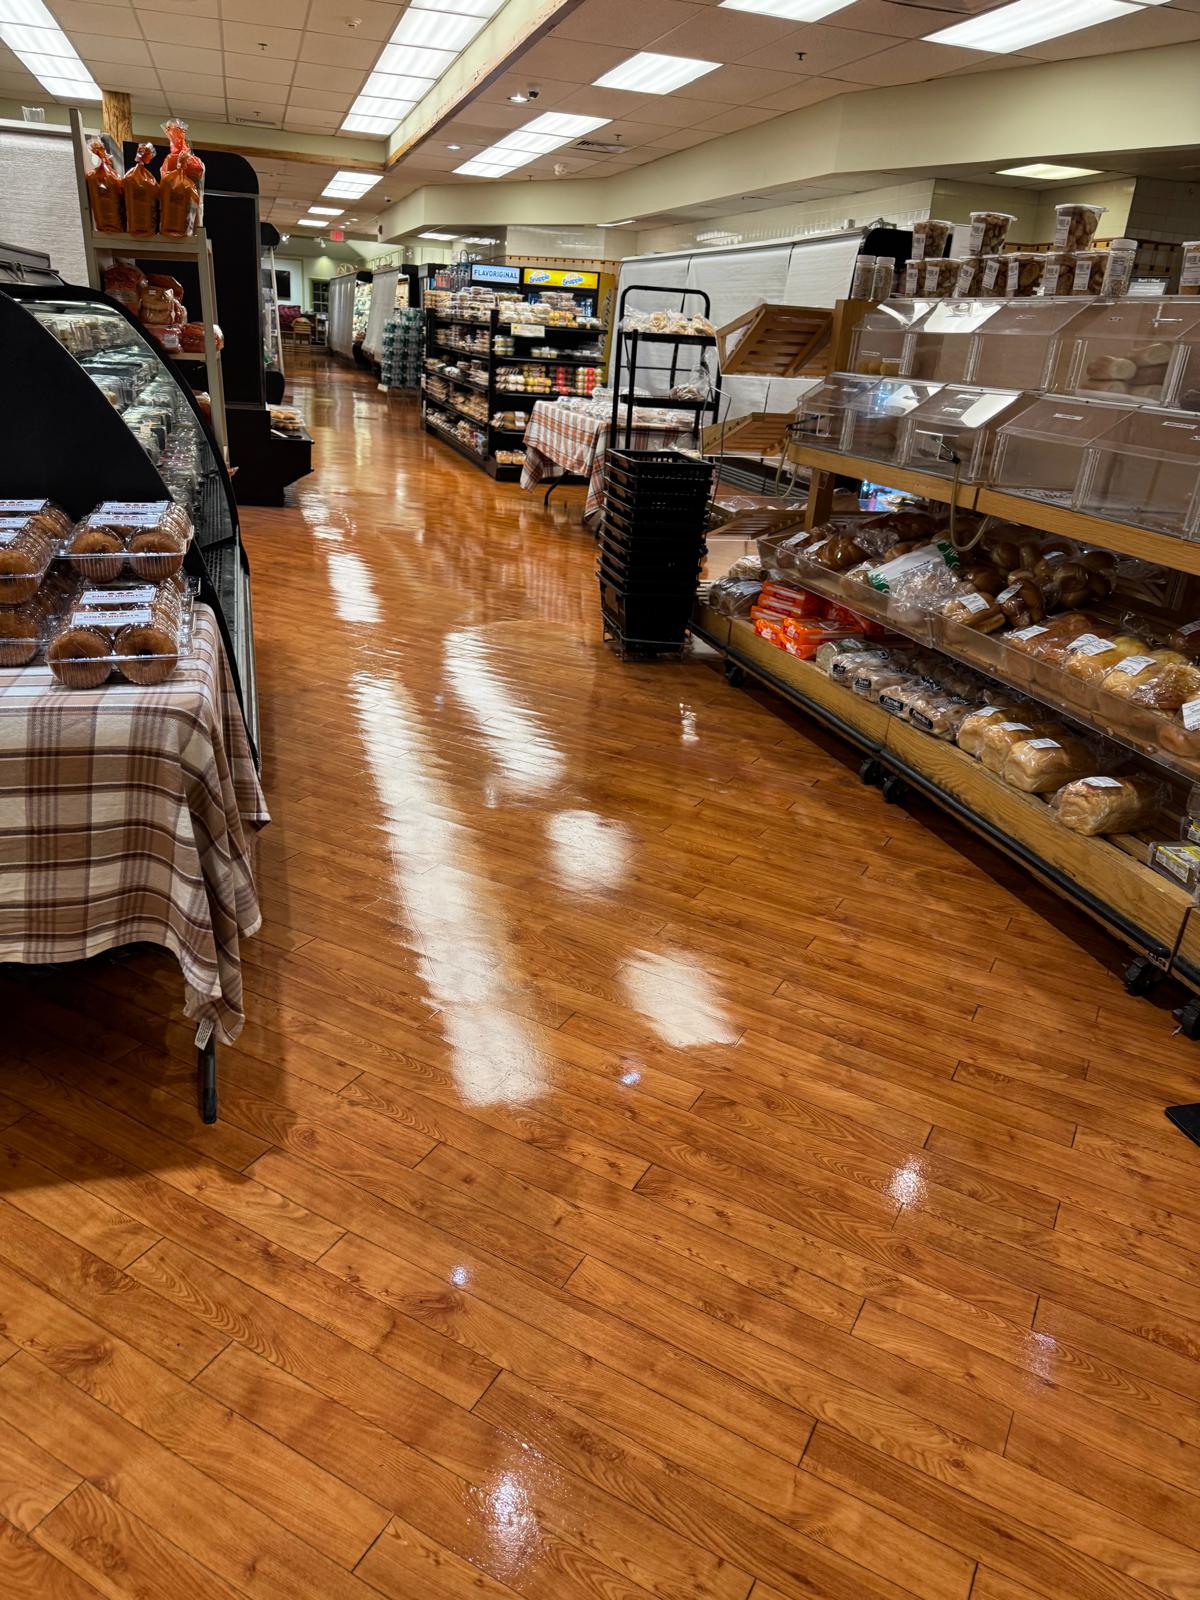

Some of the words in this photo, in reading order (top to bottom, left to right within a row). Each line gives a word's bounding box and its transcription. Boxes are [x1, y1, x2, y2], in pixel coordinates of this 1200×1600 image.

[474, 269, 518, 279] FLAVORIGINAL
[529, 273, 550, 284] Snapple
[562, 276, 584, 287] Snapple
